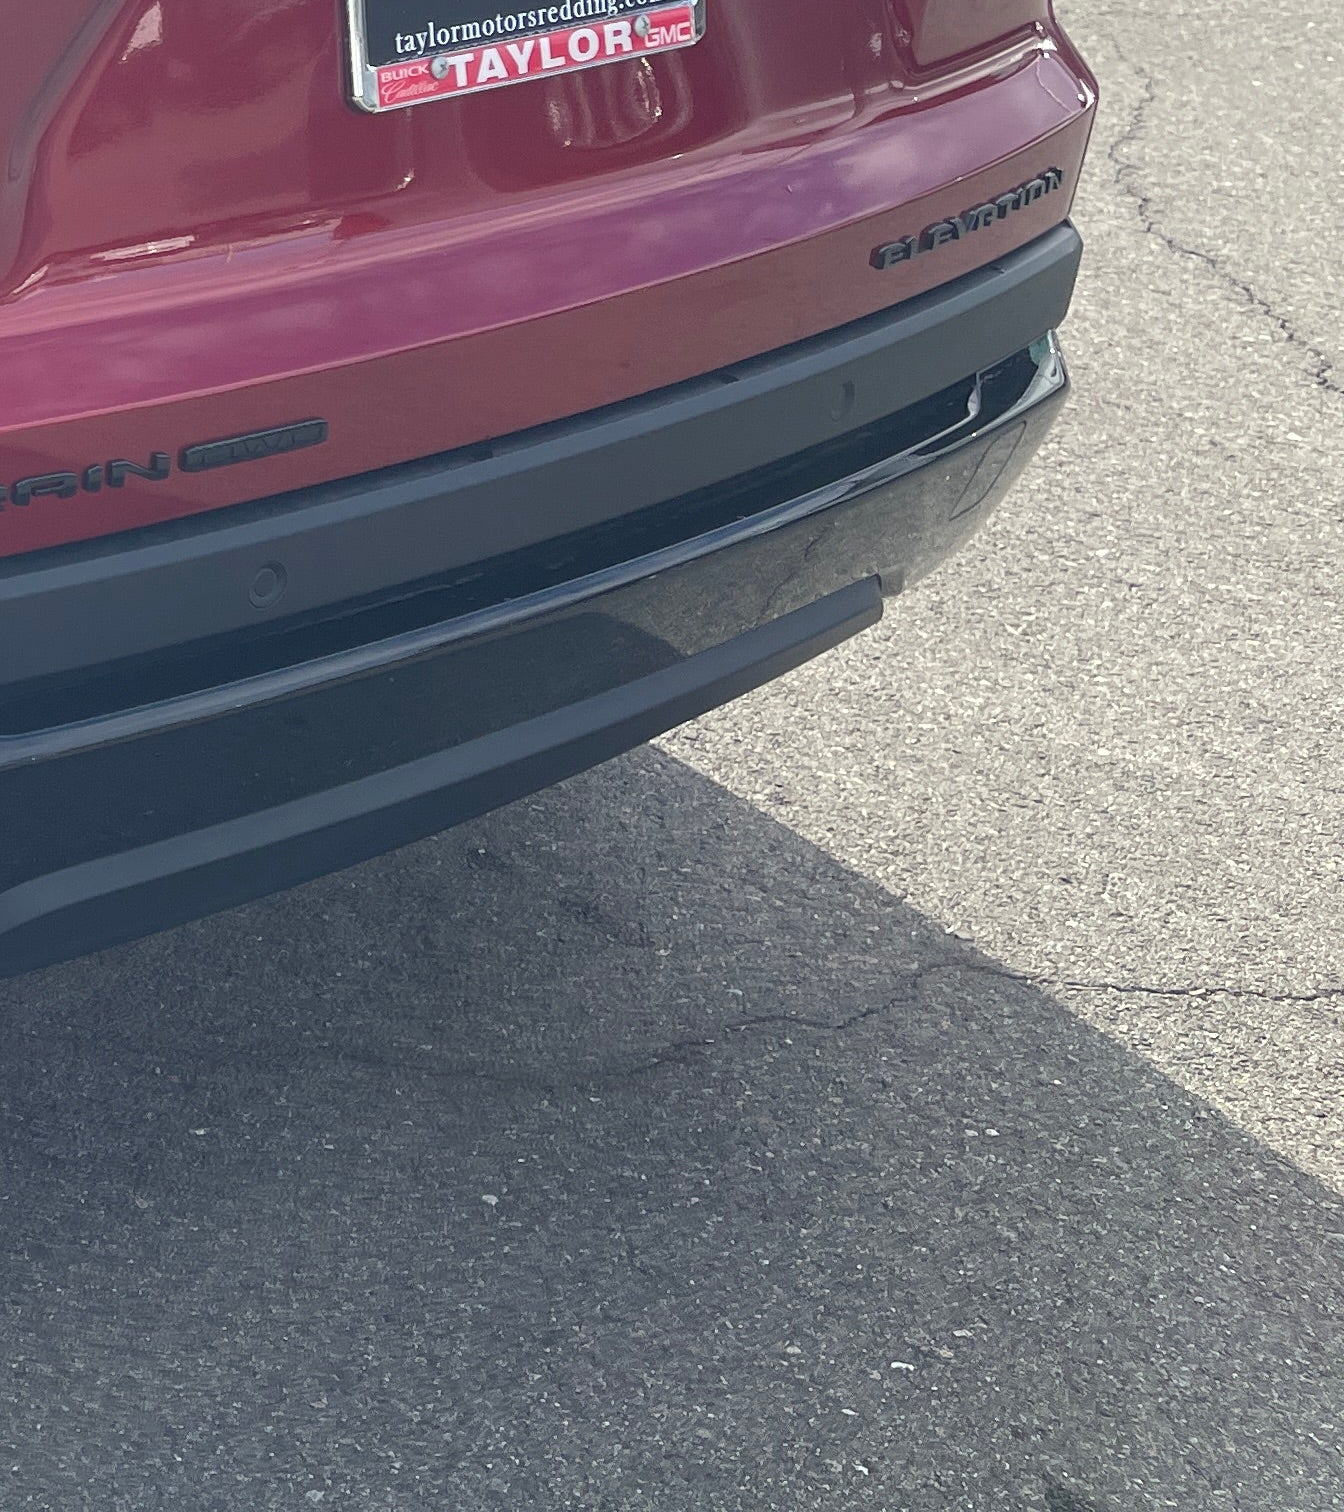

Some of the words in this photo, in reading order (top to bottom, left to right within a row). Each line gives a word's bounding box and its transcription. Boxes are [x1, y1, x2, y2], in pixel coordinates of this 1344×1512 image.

[381, 64, 430, 83] BUICK
[446, 20, 634, 89] TAYLOR
[645, 21, 694, 48] GMC
[869, 166, 1064, 270] ELEVATION
